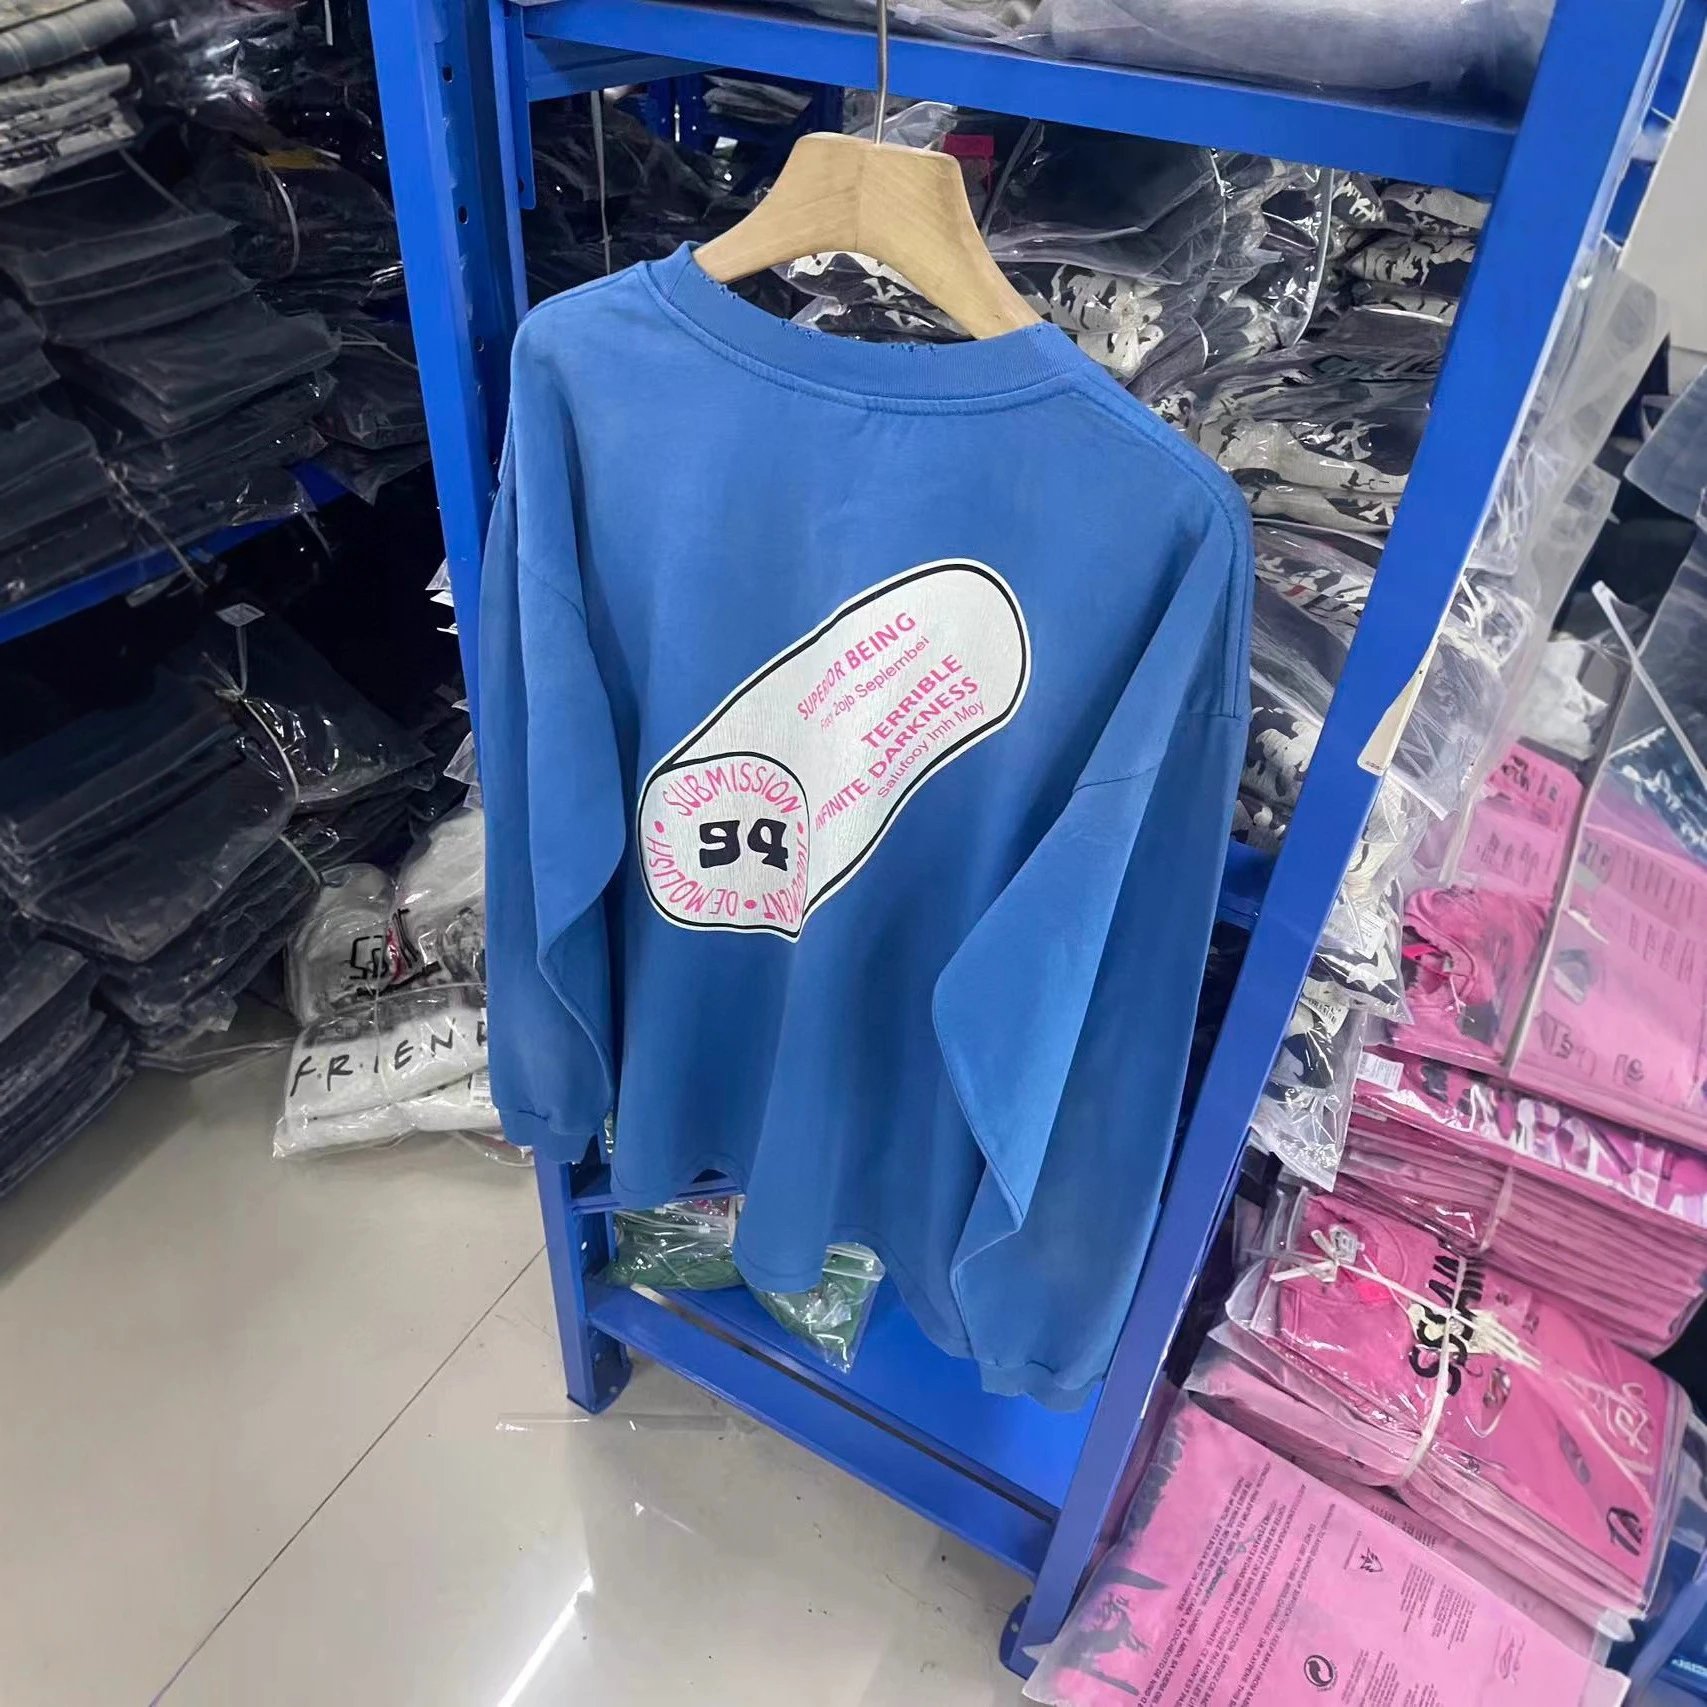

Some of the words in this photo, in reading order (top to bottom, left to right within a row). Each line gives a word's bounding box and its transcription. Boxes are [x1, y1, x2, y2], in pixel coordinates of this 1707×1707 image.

[845, 612, 916, 671] BEING
[861, 654, 963, 750] TERRIBLE
[867, 676, 979, 779] DARKNESS
[663, 762, 802, 817] SUBMISSION
[645, 836, 739, 917] DEMOLISH
